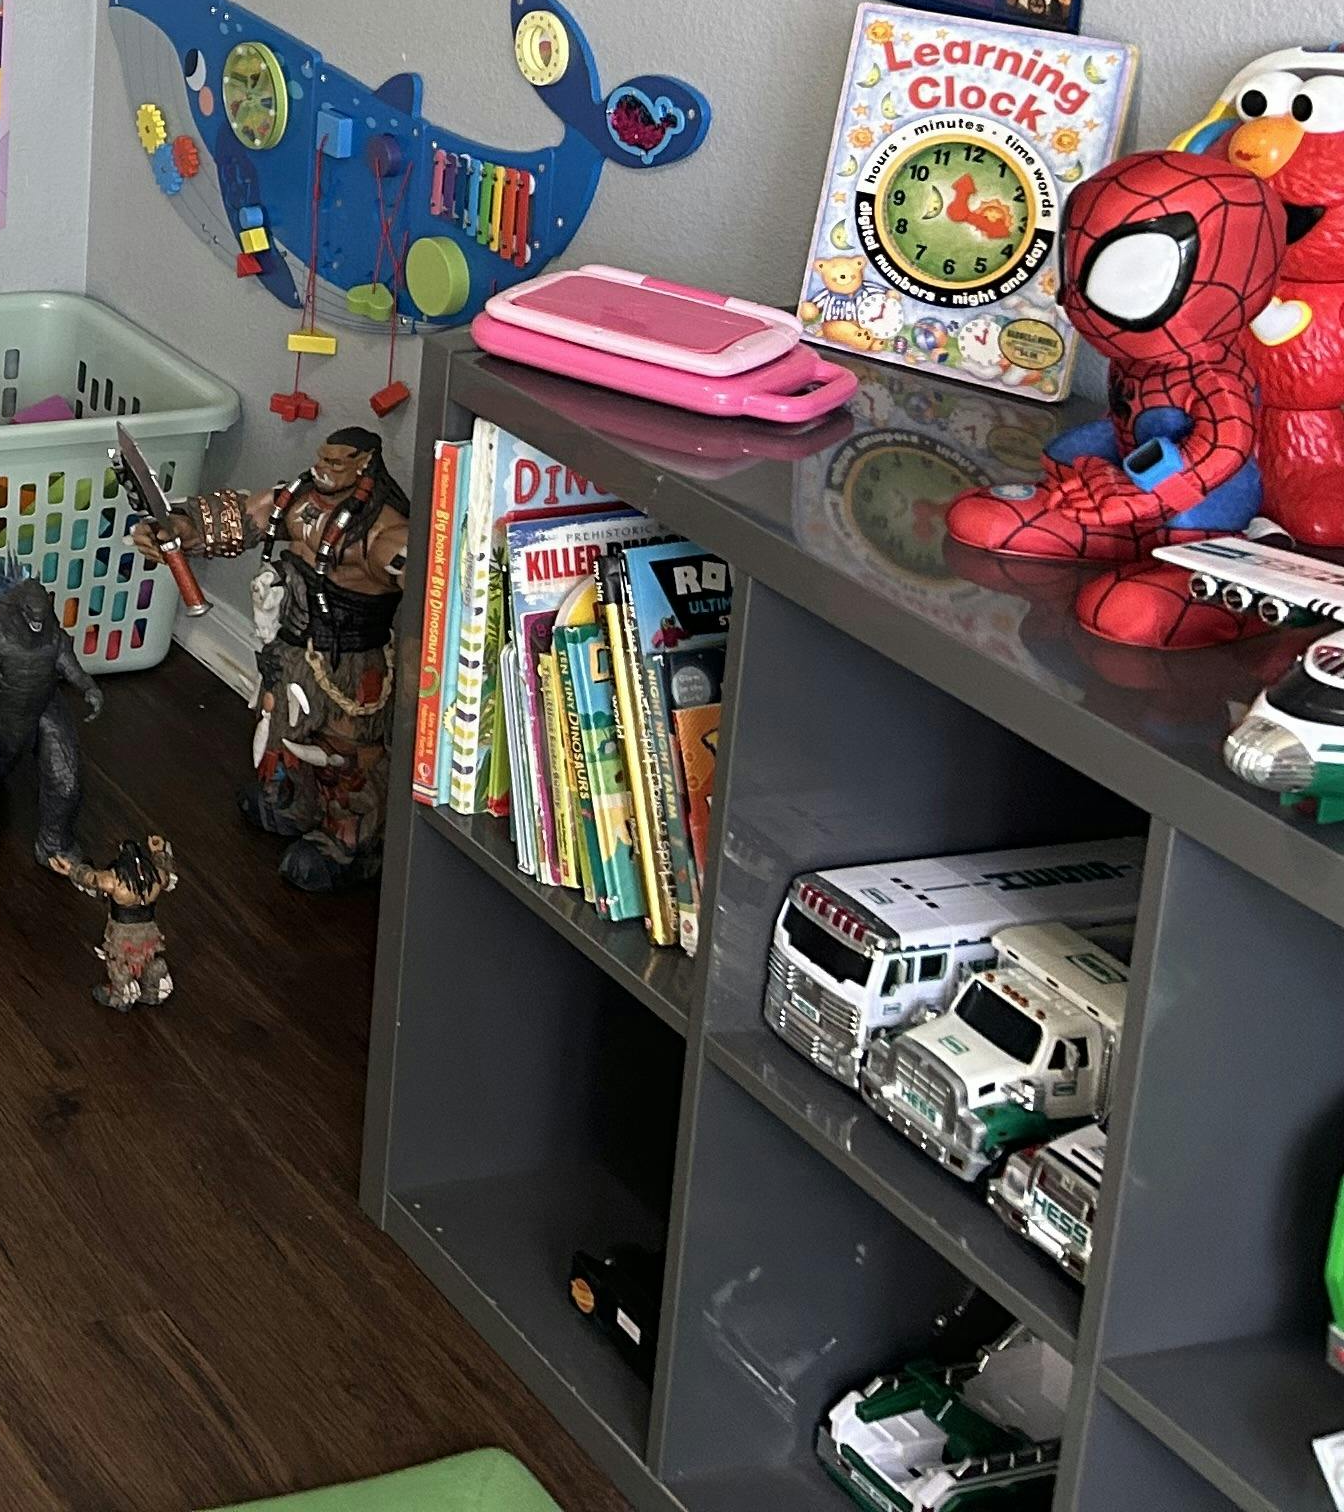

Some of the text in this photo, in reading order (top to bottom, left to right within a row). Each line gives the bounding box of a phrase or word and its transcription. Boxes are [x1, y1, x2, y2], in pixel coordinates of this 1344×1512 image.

[883, 39, 1090, 115] Learning
[908, 76, 1048, 132] Clock
[865, 119, 1051, 217] hours minutes time words
[858, 201, 1048, 306] digital numbers night and day
[525, 545, 601, 582] KILLER
[566, 526, 651, 542] PREHISTORIC
[558, 650, 590, 799] TEN TINY DINOSAURS
[647, 669, 678, 818] NIGHT NIGHT FARM
[901, 1088, 937, 1123] HESS
[1032, 1191, 1088, 1243] HESS
